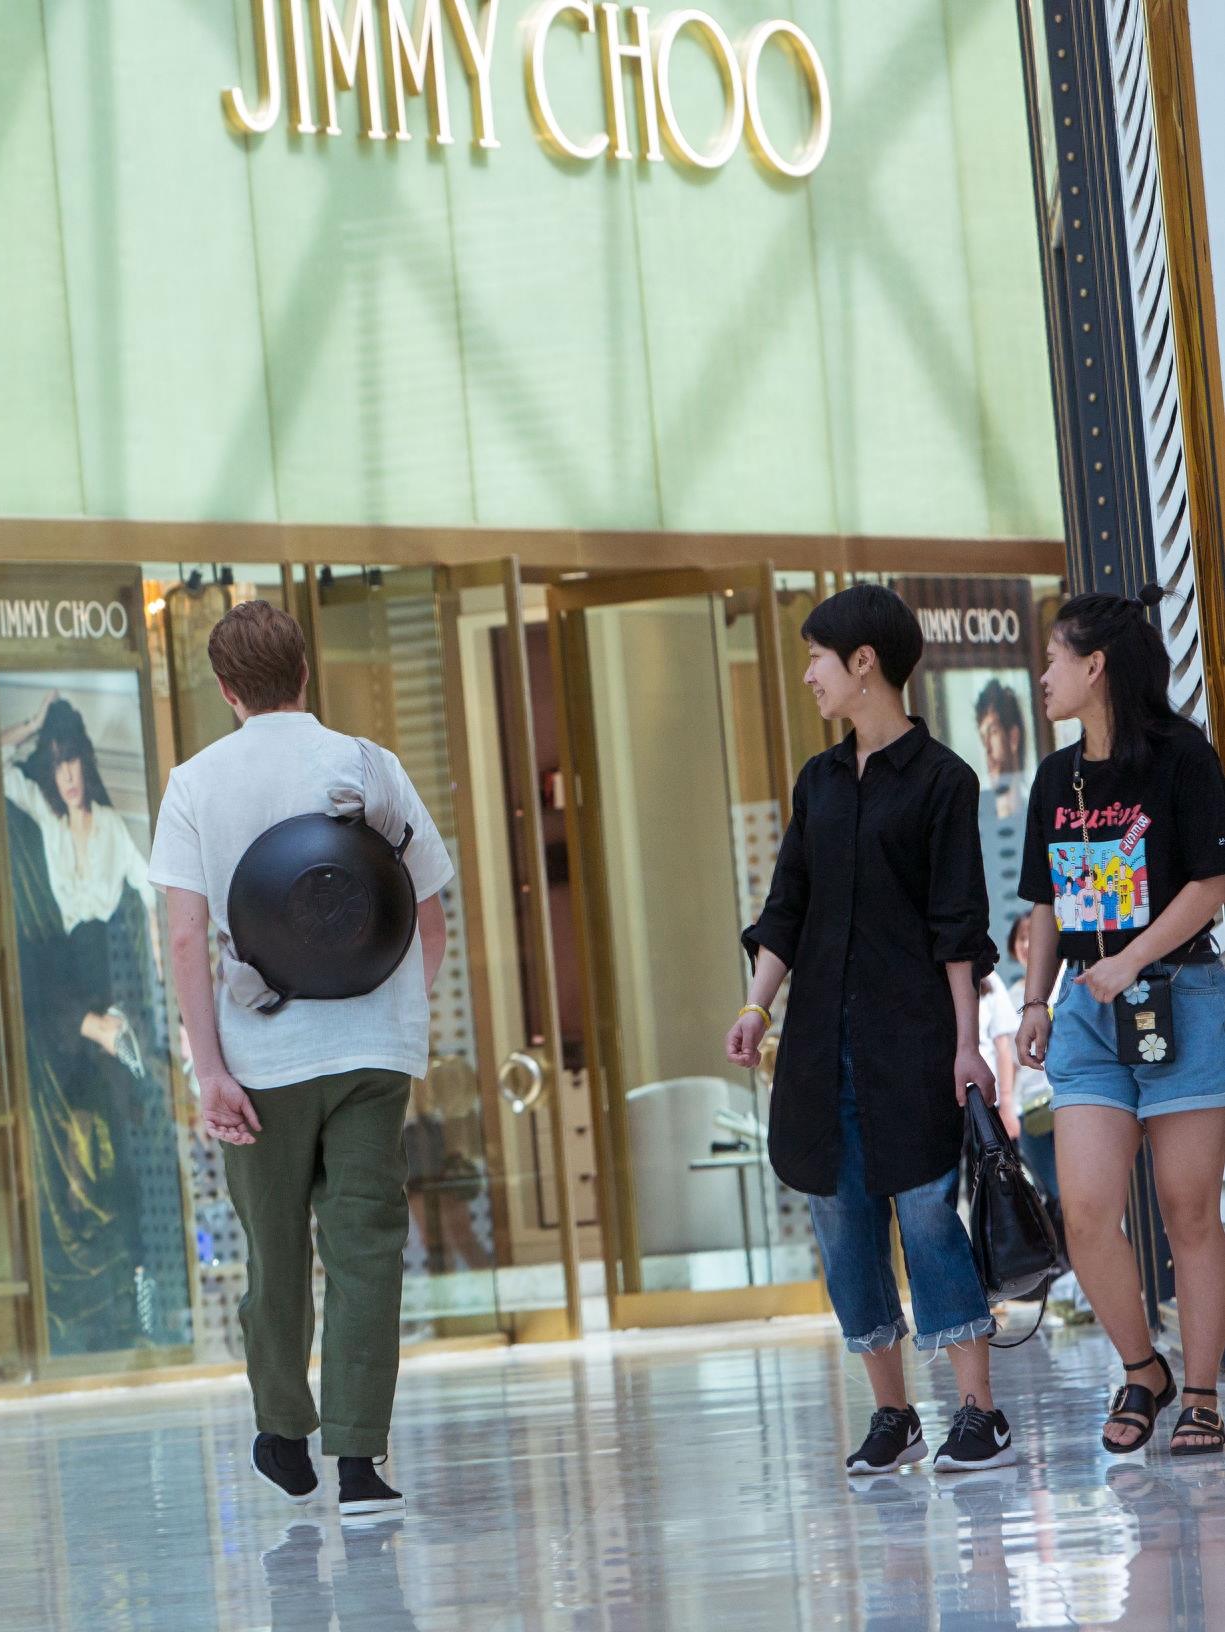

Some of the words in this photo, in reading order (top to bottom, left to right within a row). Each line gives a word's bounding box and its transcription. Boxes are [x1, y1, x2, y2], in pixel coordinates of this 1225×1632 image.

[221, 0, 500, 149] JIMMY
[526, 2, 831, 177] CHOO
[55, 600, 127, 639] CHOO
[964, 608, 1020, 643] CHOO
